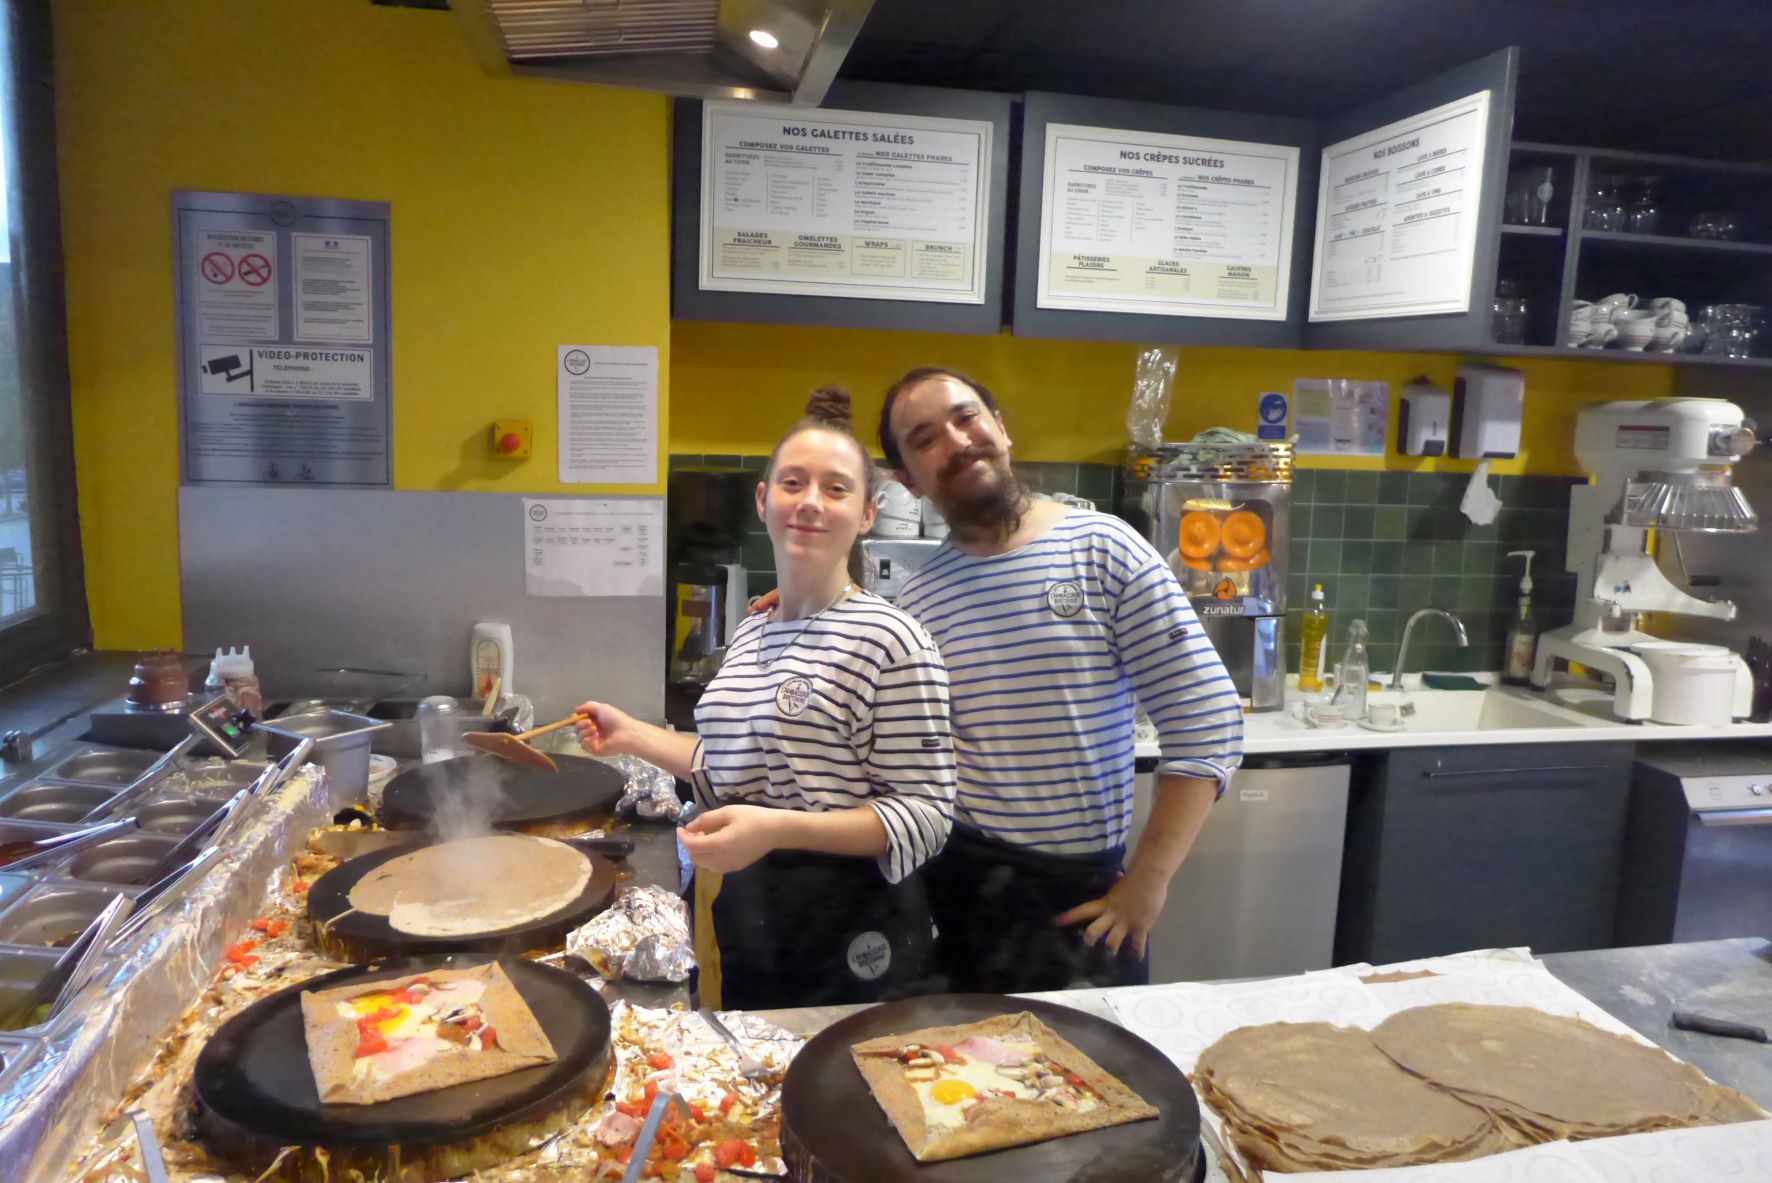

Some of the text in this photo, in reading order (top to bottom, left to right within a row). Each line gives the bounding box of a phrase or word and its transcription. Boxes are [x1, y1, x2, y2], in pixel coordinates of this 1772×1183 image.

[782, 126, 914, 145] NOS GALETTES SALÉES
[739, 141, 777, 149] COMPOSEZ
[1373, 138, 1420, 160] NOS BOISSONS
[891, 152, 925, 160] GALETTES
[926, 154, 952, 162] PHARES
[1120, 150, 1224, 168] NOS CRÊPES SUCRÉES
[1084, 164, 1116, 173] COMPOSEZ
[737, 231, 768, 239] SALADES
[798, 234, 838, 243] OMELETTES
[794, 241, 842, 250] GOURMANDES
[864, 240, 889, 248] WRAPS
[925, 244, 952, 252] BRUNCH
[1203, 605, 1244, 615] zunatur
